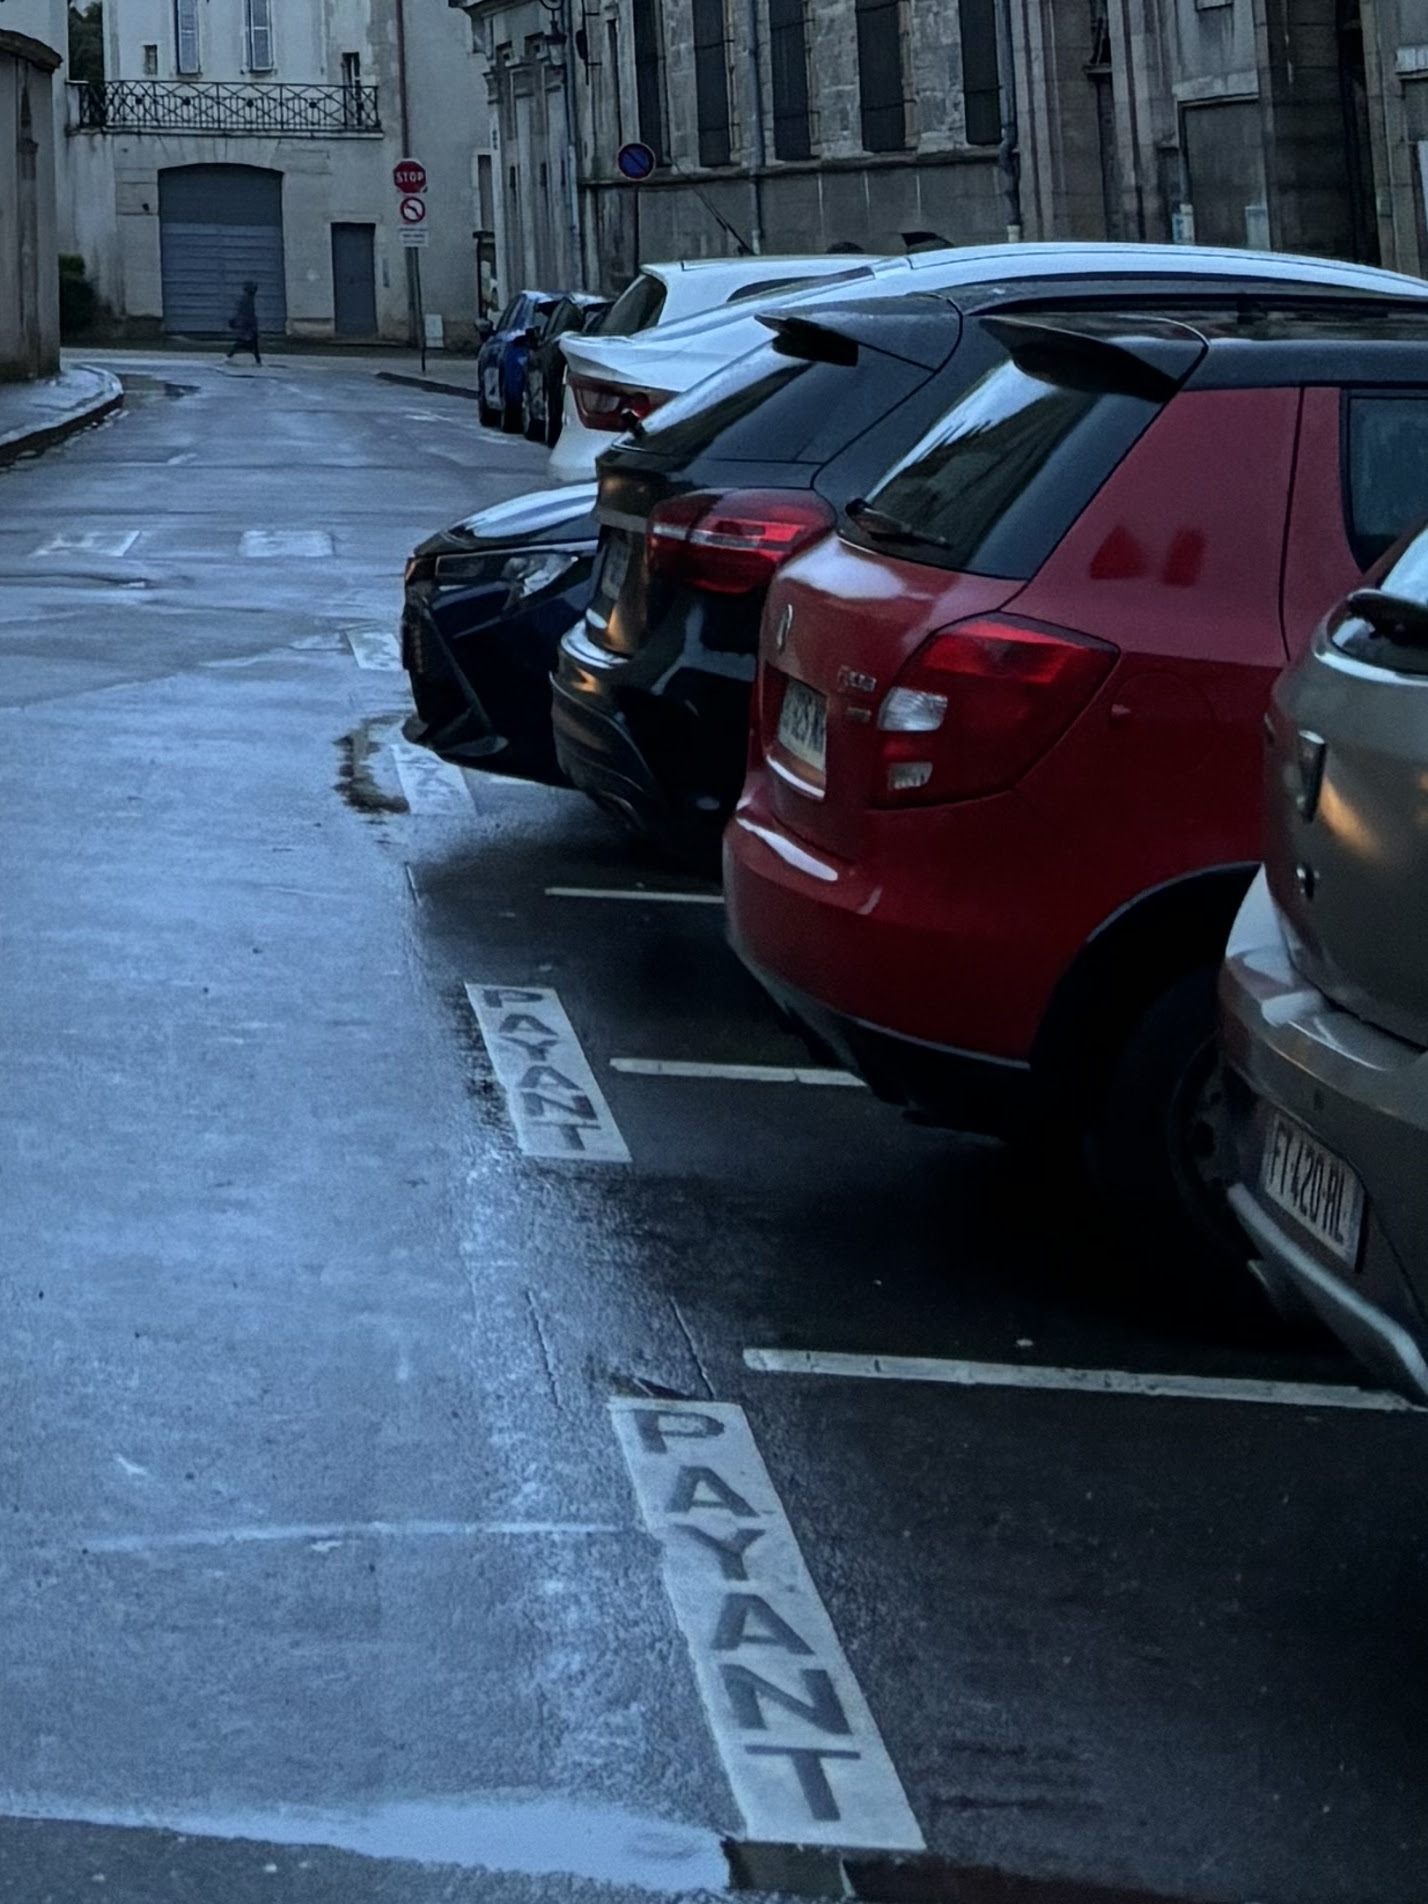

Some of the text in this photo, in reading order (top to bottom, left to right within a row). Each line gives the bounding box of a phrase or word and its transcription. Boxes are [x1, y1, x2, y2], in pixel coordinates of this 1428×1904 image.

[396, 171, 424, 183] STOP
[482, 988, 602, 1151] PAYANT
[635, 1409, 862, 1822] PAYANT
